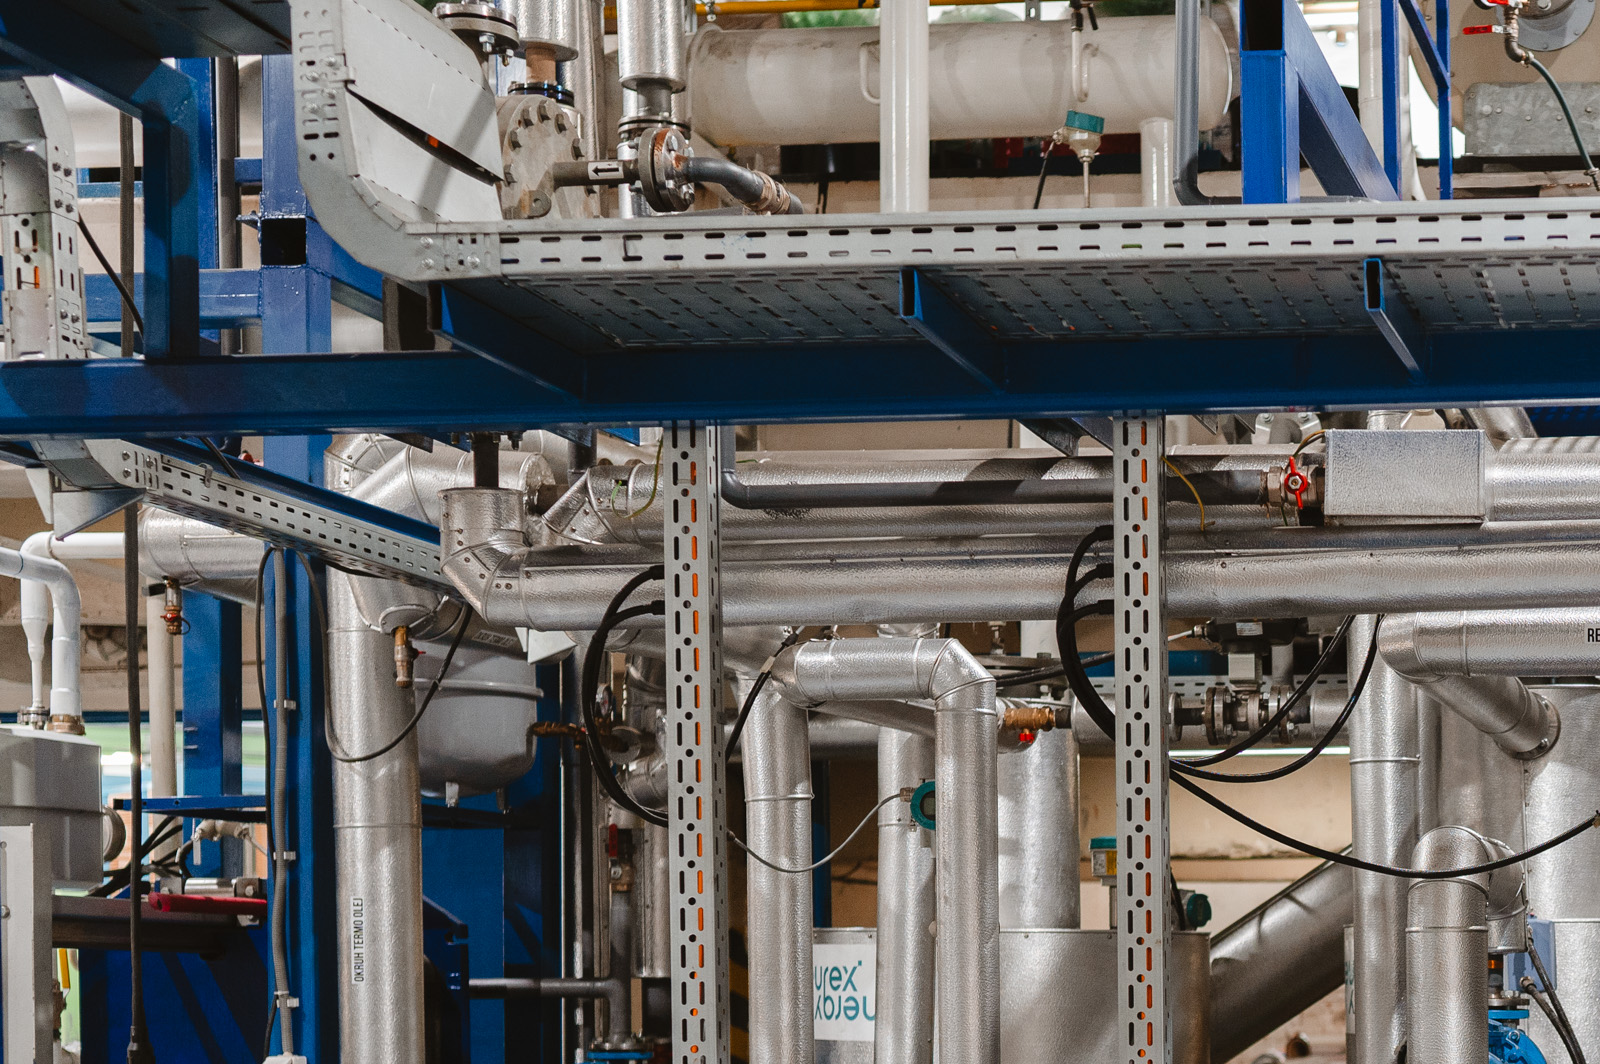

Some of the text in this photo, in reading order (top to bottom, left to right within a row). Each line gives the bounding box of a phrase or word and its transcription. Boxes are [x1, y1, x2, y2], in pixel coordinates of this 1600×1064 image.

[352, 897, 365, 983] OKRUH TERMO OLEJ
[814, 964, 858, 993] urex
[814, 995, 876, 1021] nergy
